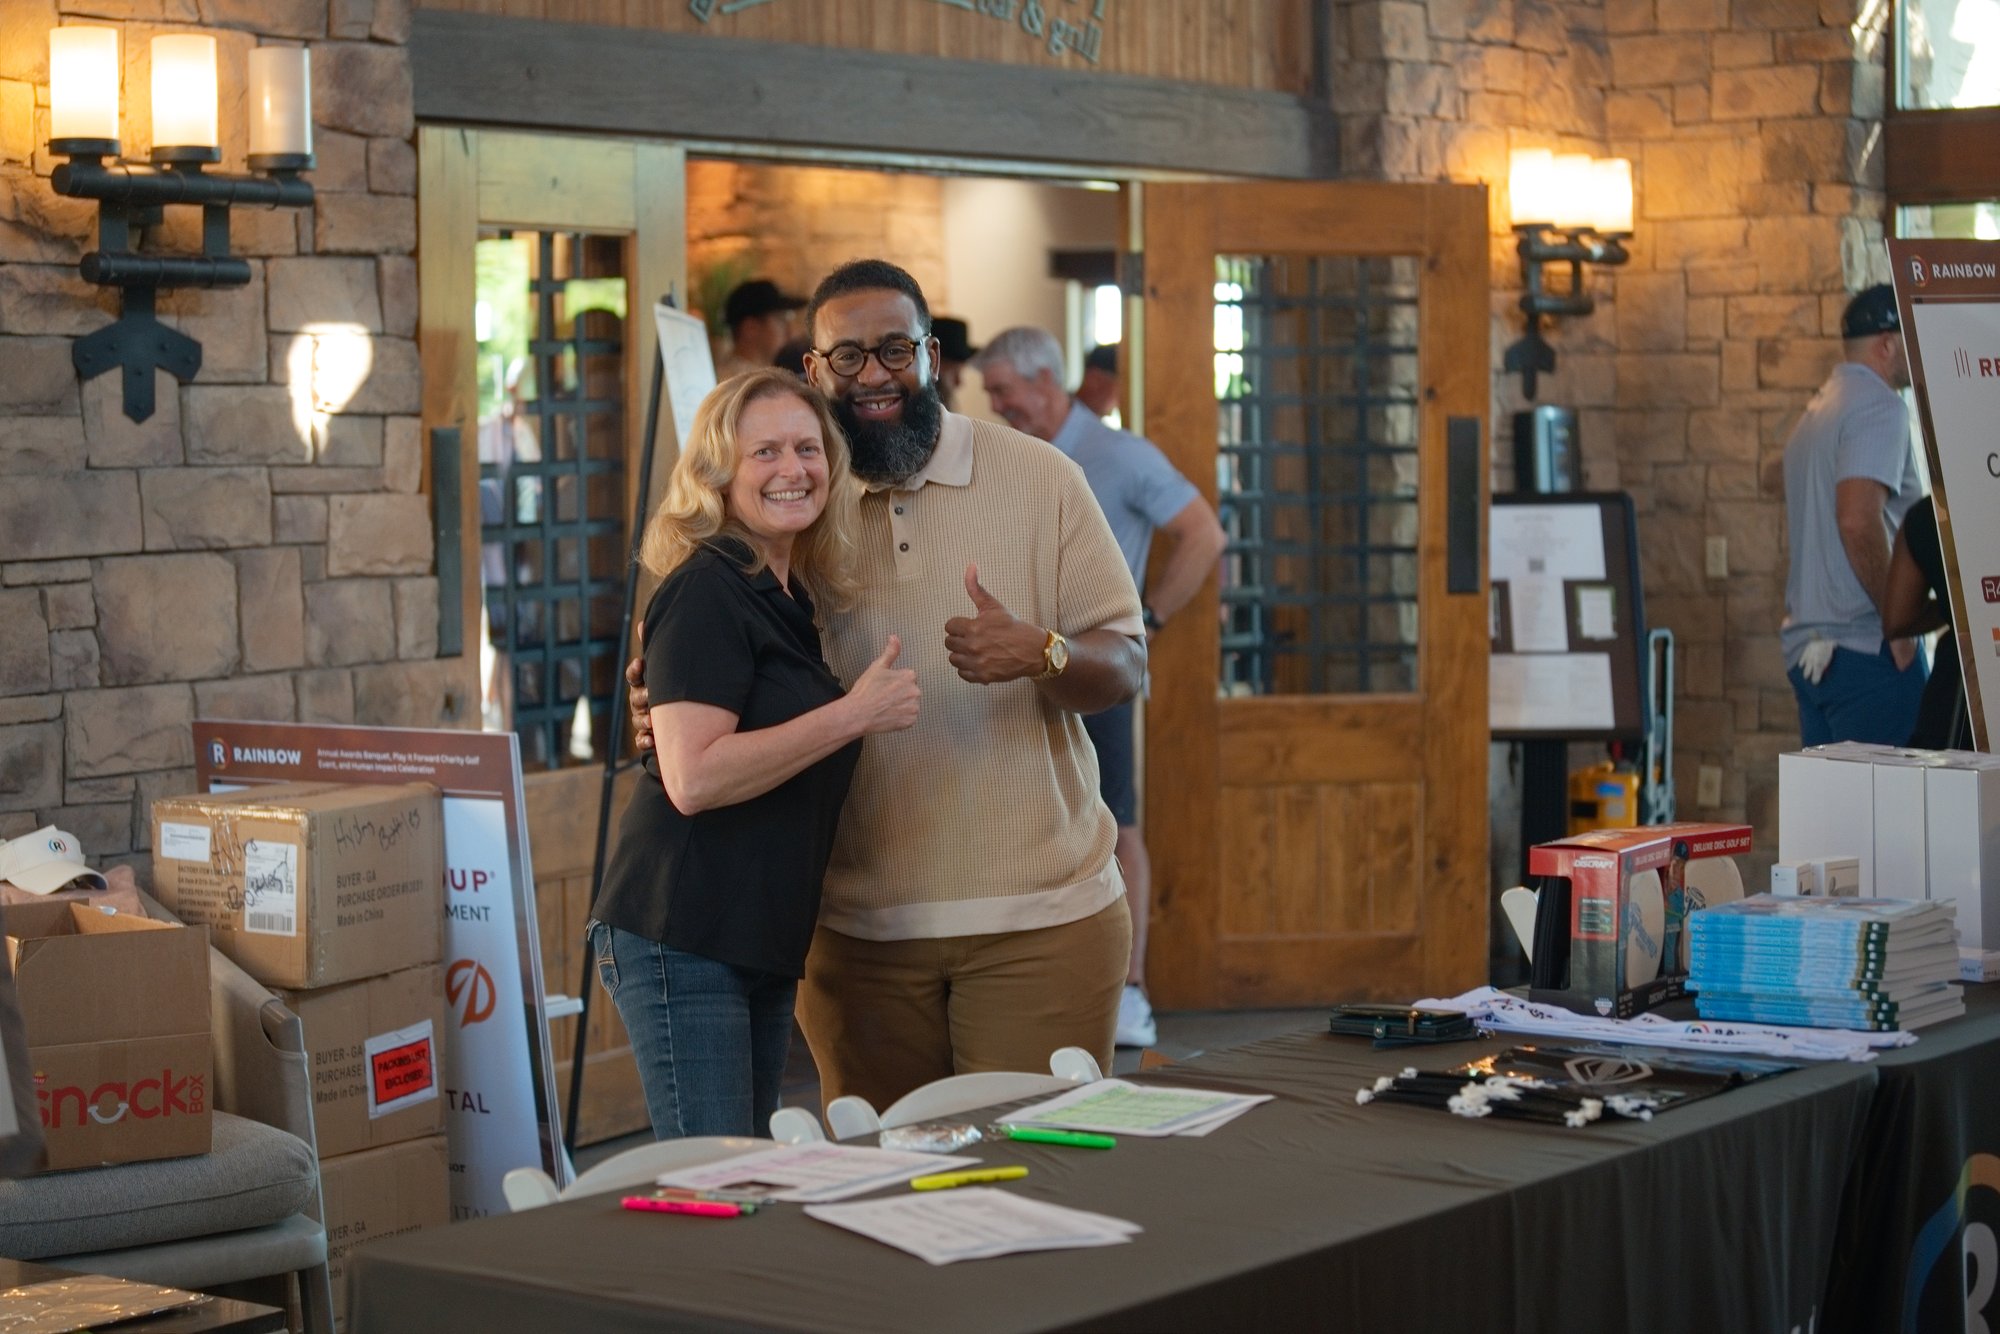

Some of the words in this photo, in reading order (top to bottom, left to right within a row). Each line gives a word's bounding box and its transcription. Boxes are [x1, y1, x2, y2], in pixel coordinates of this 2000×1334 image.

[1048, 17, 1102, 64] grill
[1931, 263, 1997, 279] RAINBOW
[233, 747, 302, 766] RAINBOW
[340, 750, 362, 760] Awards
[392, 752, 407, 763] Play
[413, 753, 440, 763] Forward
[440, 754, 464, 767] Charity
[465, 755, 480, 765] Golf
[318, 759, 338, 770] Event,
[339, 761, 350, 770] and
[351, 761, 374, 772] Human
[375, 762, 397, 774] Impact
[398, 763, 435, 775] Celebration
[1693, 842, 1713, 853] DELUXE
[1714, 840, 1726, 850] DISC
[1727, 838, 1740, 849] GOLF
[1740, 837, 1750, 847] SET
[337, 872, 361, 889] BUYER
[366, 869, 377, 884] GA
[337, 888, 376, 908] PURCHASE
[377, 882, 400, 901] ORDER
[337, 911, 356, 928] Made
[364, 907, 384, 922] China
[316, 1048, 345, 1066] BUYER
[351, 1045, 363, 1057] GA
[377, 1054, 411, 1075] PACKING
[411, 1048, 426, 1062] LIST
[316, 1064, 363, 1085] PURCHASE
[189, 1074, 204, 1114] BOX
[316, 1088, 338, 1104] Made
[341, 1086, 348, 1098] in
[348, 1084, 368, 1097] Chin
[354, 1220, 367, 1235] GA
